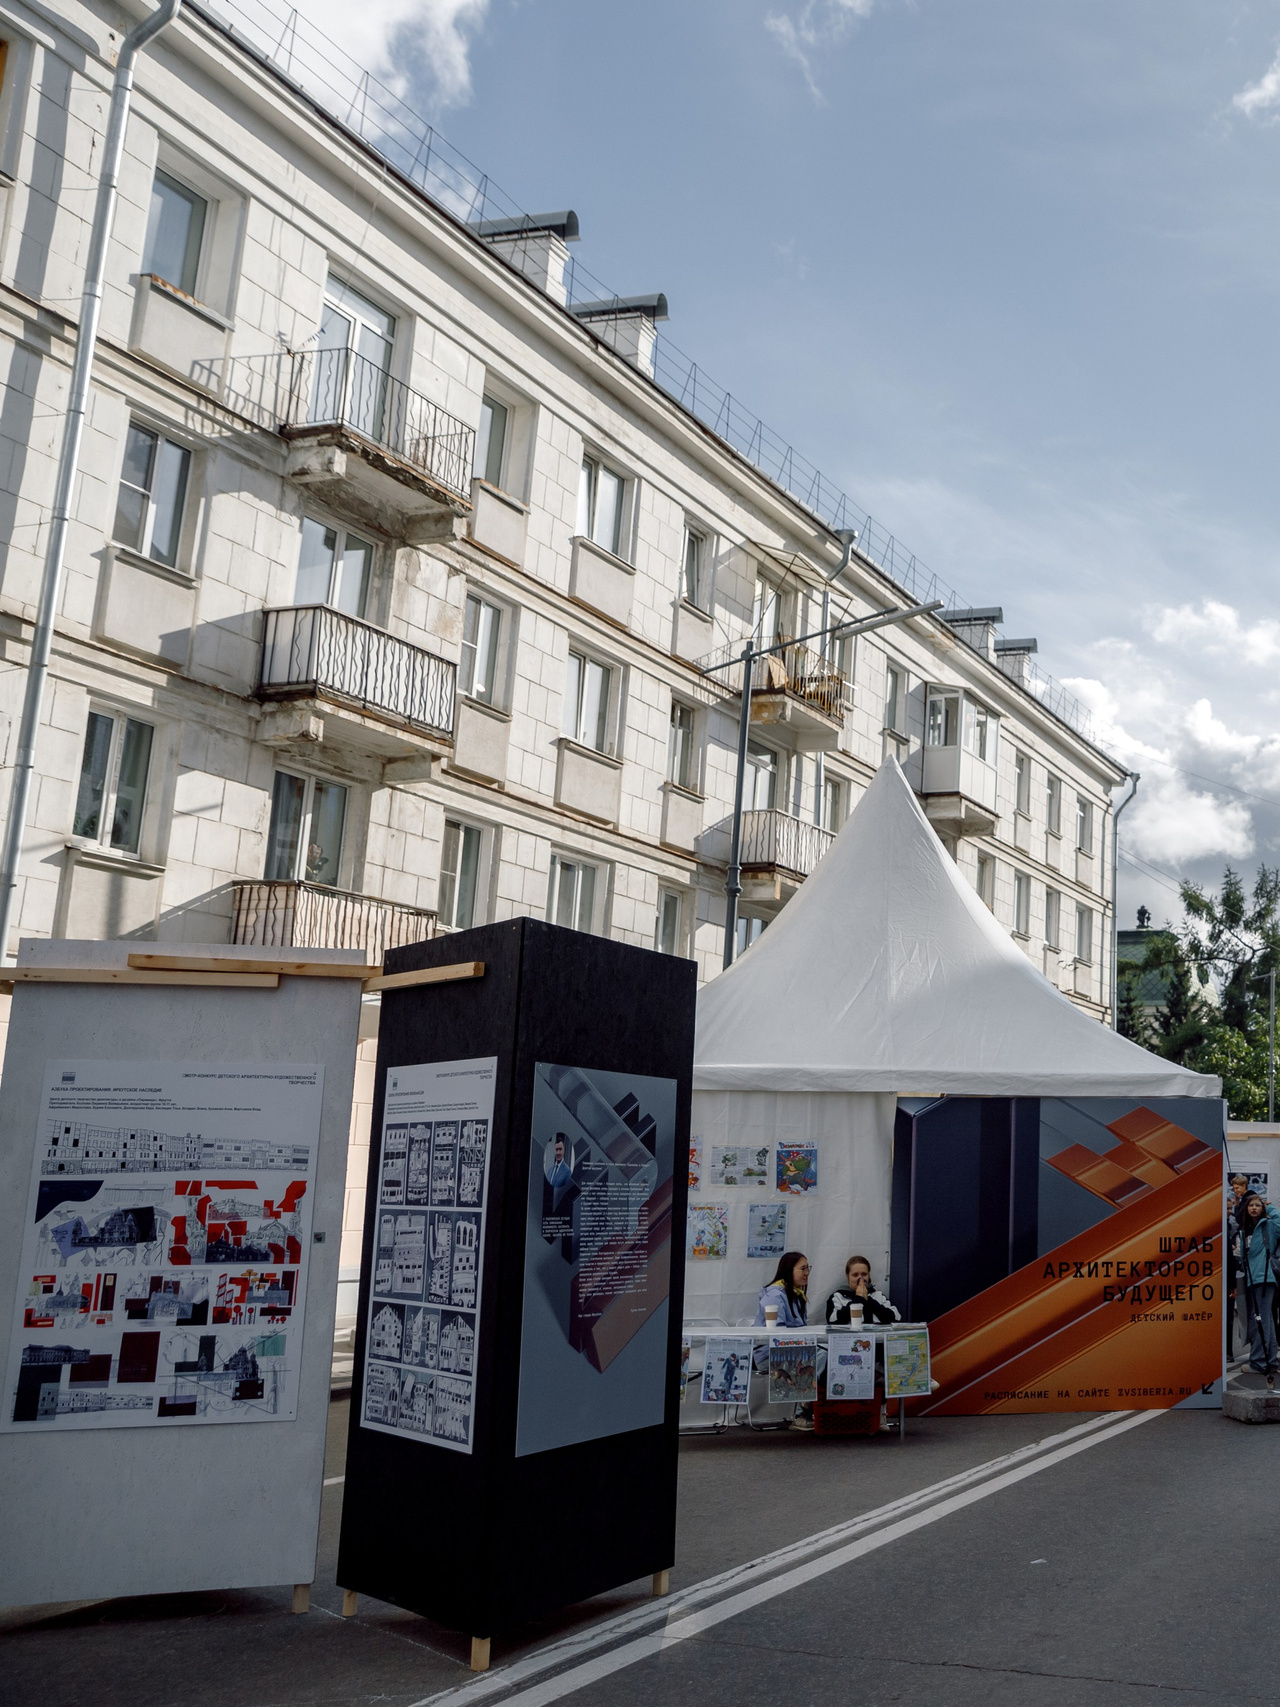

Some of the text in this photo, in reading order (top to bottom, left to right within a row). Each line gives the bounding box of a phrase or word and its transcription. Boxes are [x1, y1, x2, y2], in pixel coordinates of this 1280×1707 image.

[1159, 1237, 1213, 1253] ШТАБ
[1043, 1260, 1214, 1279] АРХИТЕКТОРОВ
[1103, 1284, 1214, 1305] БУДУЩЕГО
[1130, 1311, 1213, 1323] ДЕТСКИЙ ШАТЁР
[984, 1387, 1192, 1400] РАСПИСАНИЕ НА САЙТЕ ZVSIBERIA.RU
